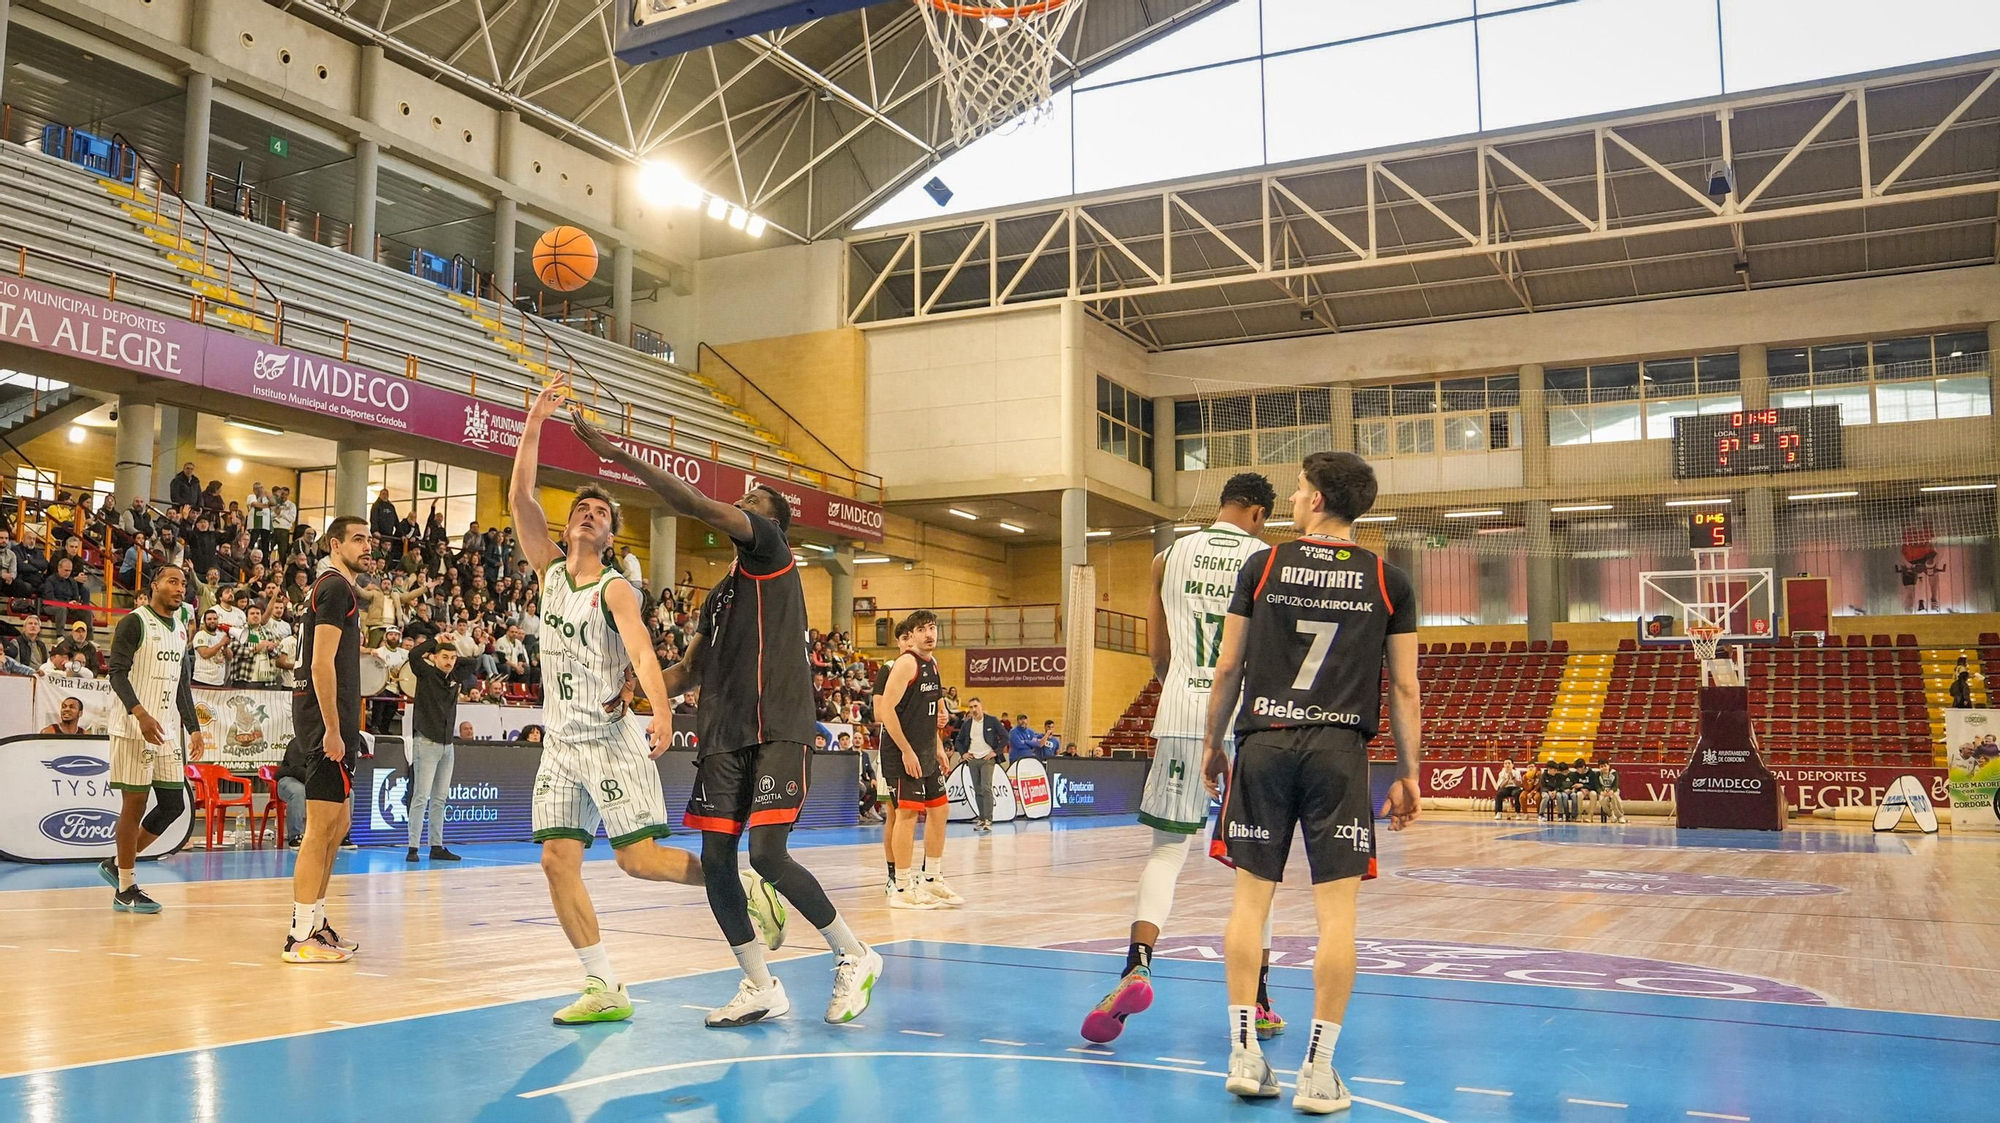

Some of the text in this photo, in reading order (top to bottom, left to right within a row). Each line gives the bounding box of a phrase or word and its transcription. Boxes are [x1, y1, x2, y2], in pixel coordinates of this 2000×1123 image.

[274, 141, 281, 152] 4
[23, 288, 99, 318] MUNICIPAL
[103, 308, 166, 334] DEPORTES
[51, 317, 182, 375] ALEGRE
[292, 356, 410, 412] IMDECO
[253, 385, 407, 429] Instituto Municipal de Deportes Córdoba
[491, 430, 499, 443] DE
[1753, 434, 1760, 443] 3
[1780, 435, 1799, 448] 37
[1720, 439, 1739, 452] 37
[1720, 457, 1728, 465] 4
[1787, 452, 1795, 462] 3
[598, 467, 621, 479] Instituto
[425, 477, 432, 489] D
[841, 504, 881, 529] IMDECO
[1713, 527, 1725, 545] 5
[1300, 546, 1334, 555] ALTUNA
[1313, 552, 1333, 561] URIA
[1194, 555, 1242, 572] SAGNIA
[1281, 566, 1364, 589] AIZPITARTE
[1266, 594, 1373, 612] GIPUZKOAKIROLAK
[157, 650, 180, 662] coto
[1291, 620, 1339, 690] 7
[992, 656, 1067, 673] IMDECO
[77, 679, 94, 691] Las
[557, 672, 573, 700] 16
[928, 702, 936, 716] 17
[1253, 697, 1361, 725] BieleGroup
[223, 741, 268, 757] SALMOREJO
[1708, 778, 1761, 789] IMDECO
[1798, 771, 1867, 781] DEPORTES
[52, 780, 114, 796] TYSA
[448, 782, 498, 799] utación
[1022, 783, 1029, 799] el
[1028, 778, 1048, 803] jamón
[444, 803, 498, 822] Córdoba
[60, 813, 117, 839] Ford
